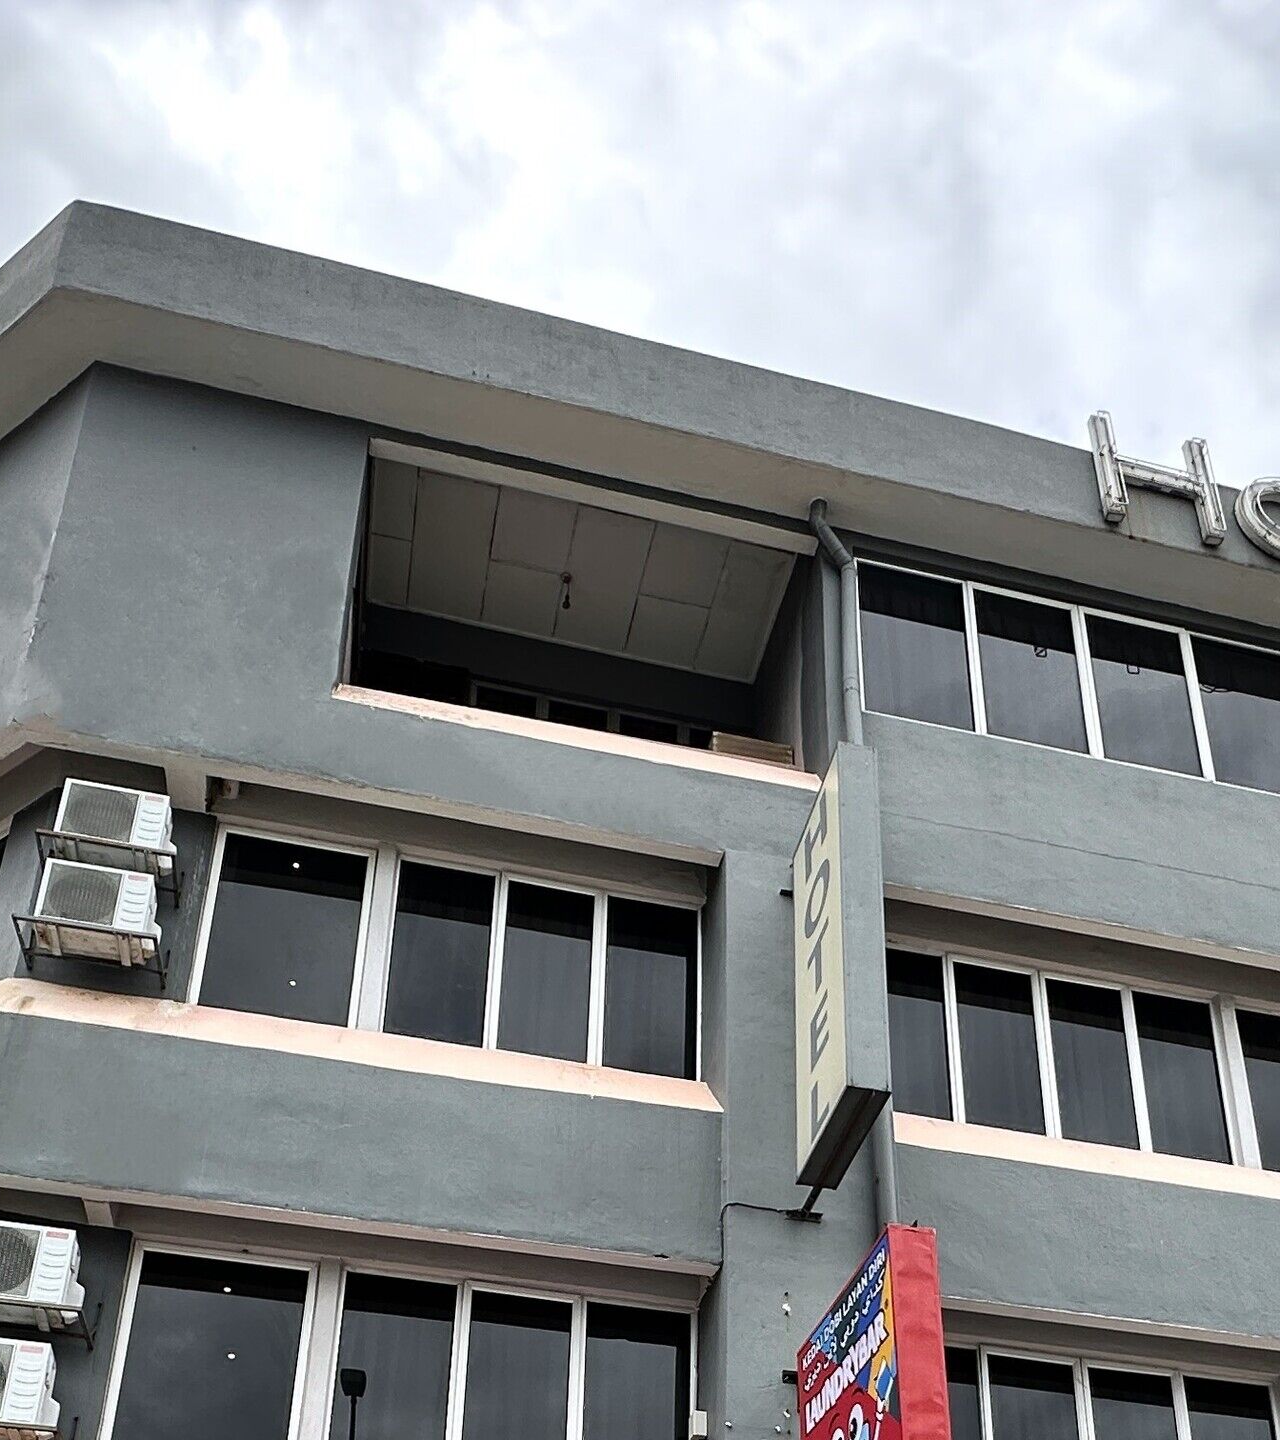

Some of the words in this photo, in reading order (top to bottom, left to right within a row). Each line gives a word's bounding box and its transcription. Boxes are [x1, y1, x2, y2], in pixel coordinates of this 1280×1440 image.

[803, 788, 830, 1134] HOTEL
[802, 1339, 822, 1370] KEDAI
[823, 1310, 843, 1338] DOBI
[842, 1274, 869, 1314] LAYAN
[868, 1248, 886, 1282] DIRI
[804, 1310, 889, 1435] LAUNDRYBAR
